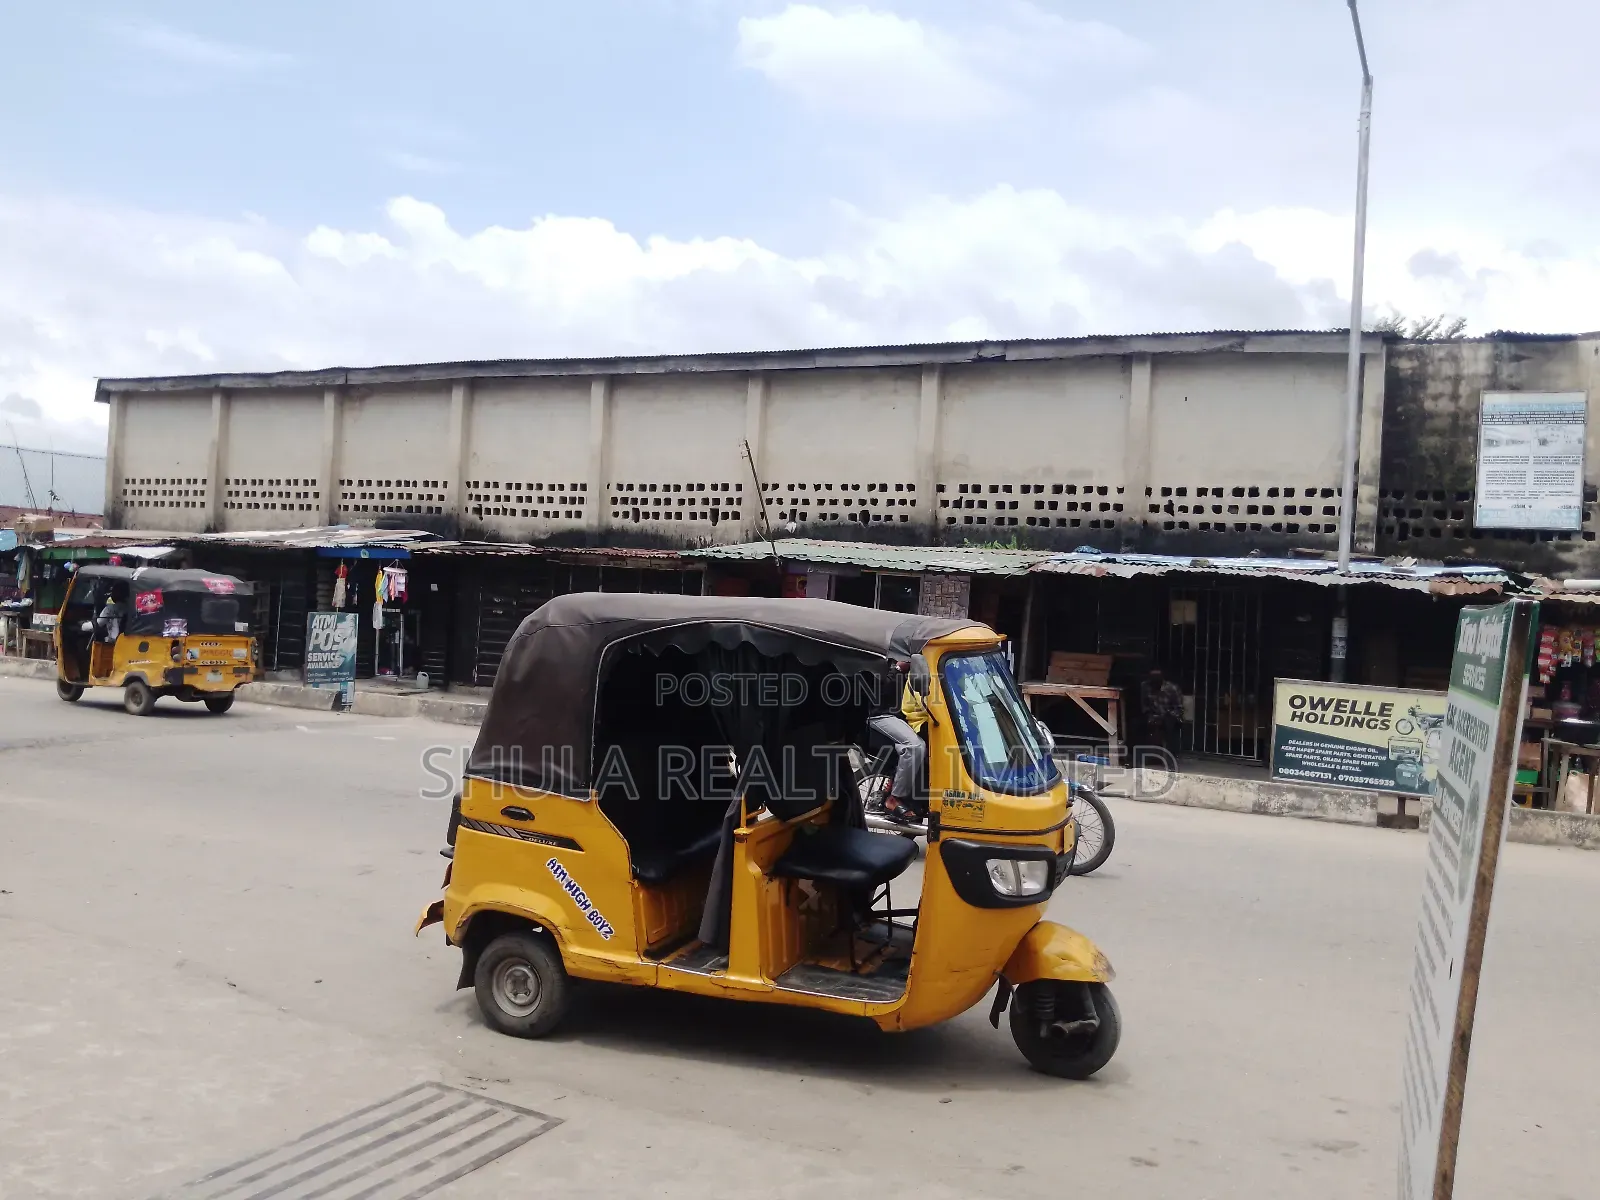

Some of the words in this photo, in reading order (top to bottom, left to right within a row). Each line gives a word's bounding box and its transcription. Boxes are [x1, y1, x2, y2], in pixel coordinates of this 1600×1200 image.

[308, 627, 344, 652] POS
[1288, 694, 1395, 718] OWELLE
[1289, 710, 1392, 731] HOLDINGS
[1288, 739, 1313, 747] DEALERS
[1345, 745, 1367, 753] ENGINE
[1315, 748, 1333, 756] SPARE
[1352, 753, 1387, 761] GENERATOR
[1301, 760, 1336, 769] WHOLESALE
[1448, 735, 1477, 789] AGENT
[528, 837, 557, 846] DELUXE
[546, 858, 568, 883] AIM
[564, 879, 592, 911] HIGH
[586, 909, 614, 940] BOYZ
